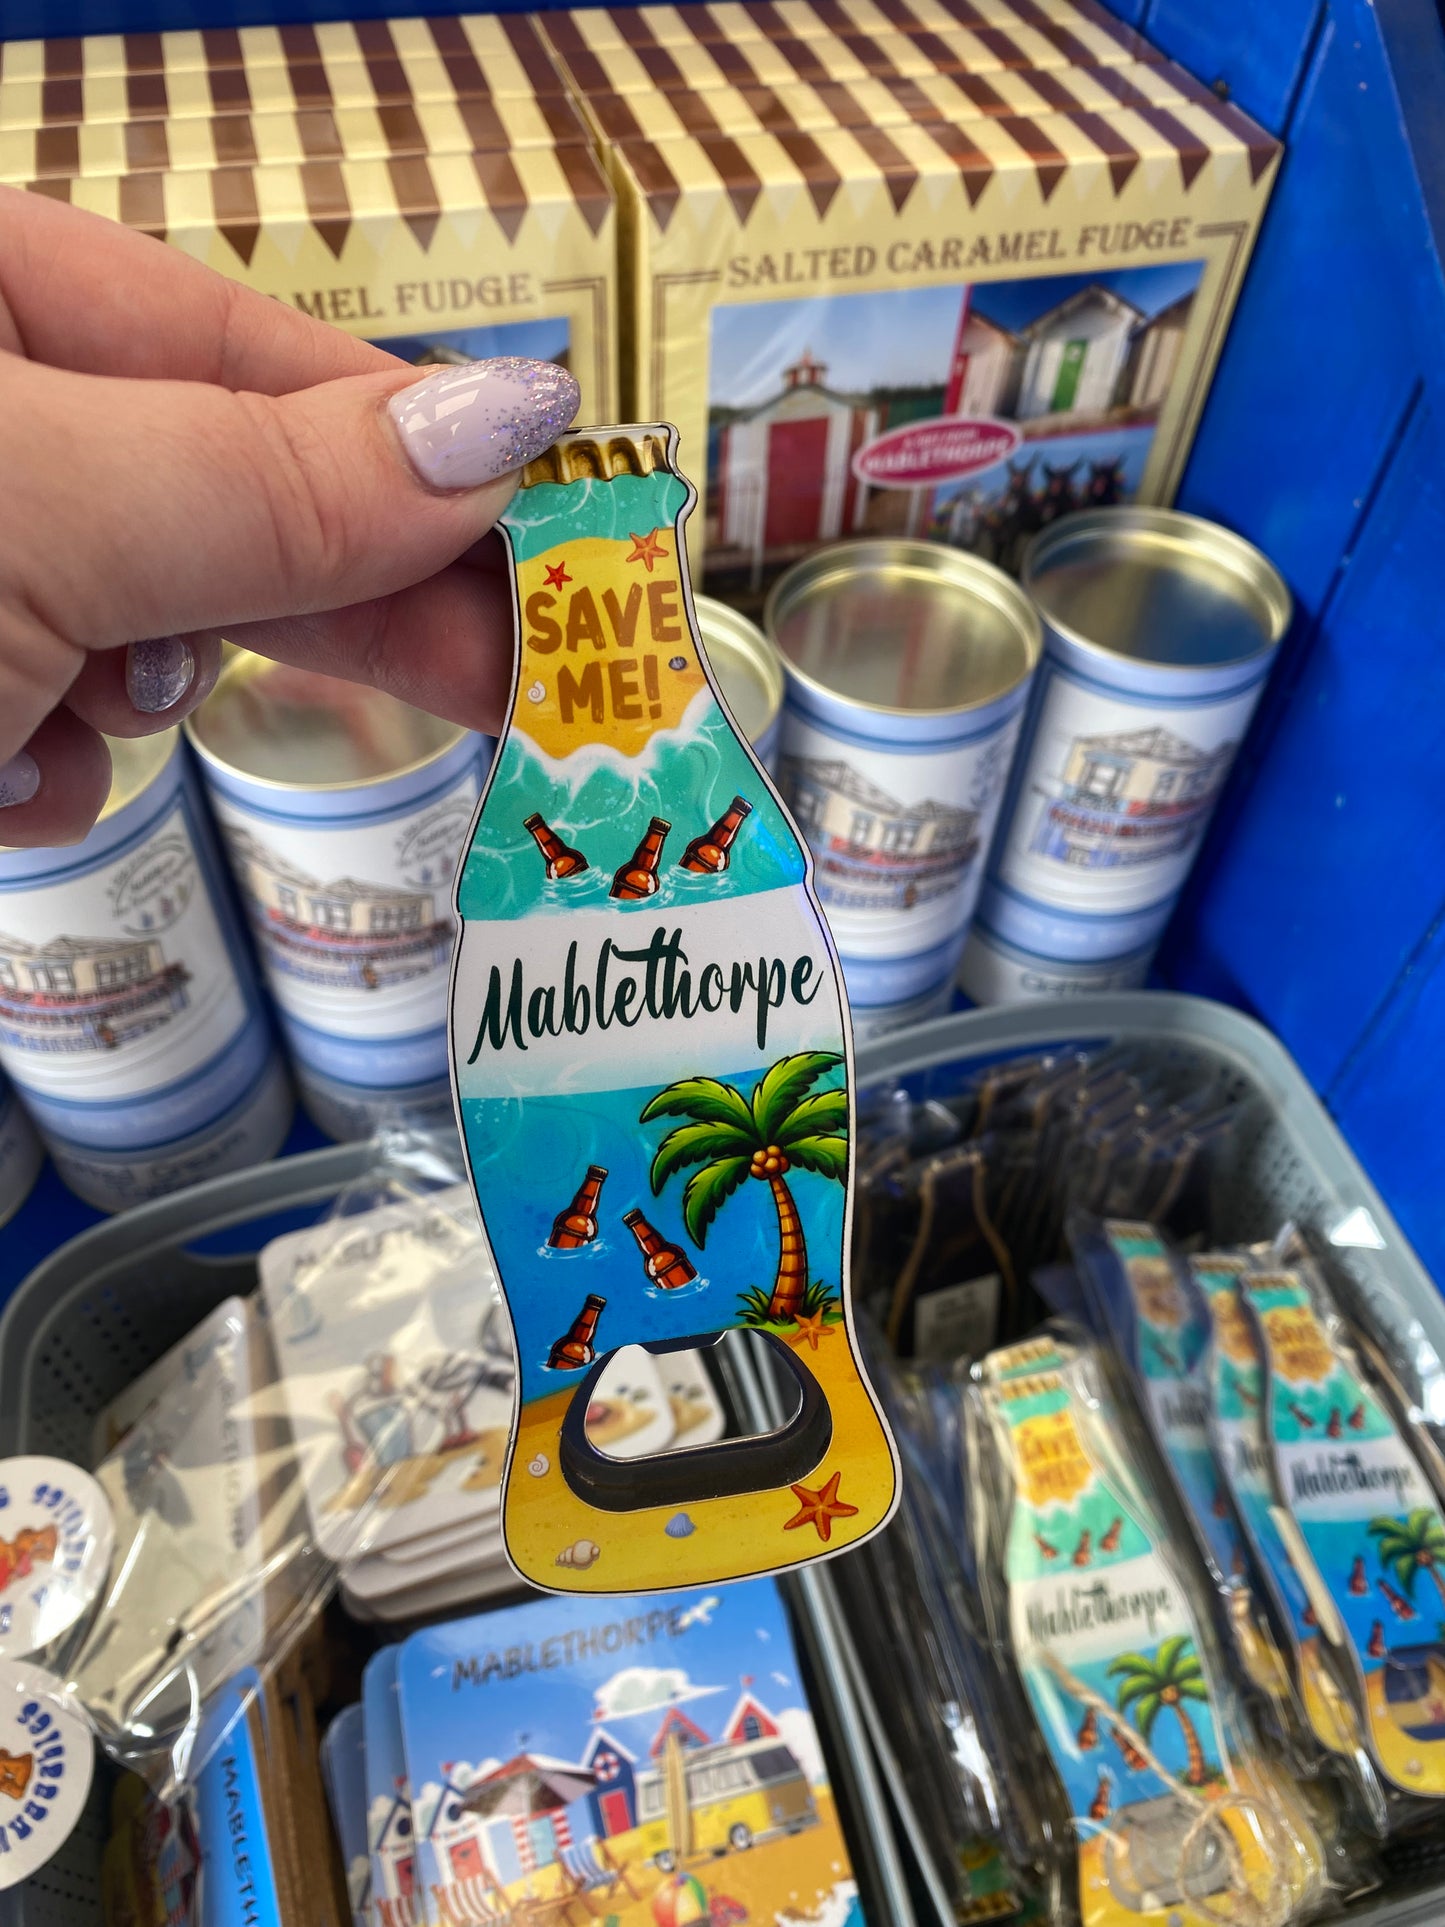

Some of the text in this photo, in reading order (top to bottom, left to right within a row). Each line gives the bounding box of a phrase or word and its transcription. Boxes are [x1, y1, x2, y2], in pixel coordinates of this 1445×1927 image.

[728, 216, 1192, 288] SALTED CARAMEL FUDGE
[396, 271, 534, 315] FUDGE
[525, 579, 682, 656] SAVE
[556, 654, 665, 725] ME!
[467, 926, 824, 1066] Mablethorpe
[1026, 1579, 1173, 1642] Mablethorpe
[452, 1604, 686, 1691] MABLETHORPE
